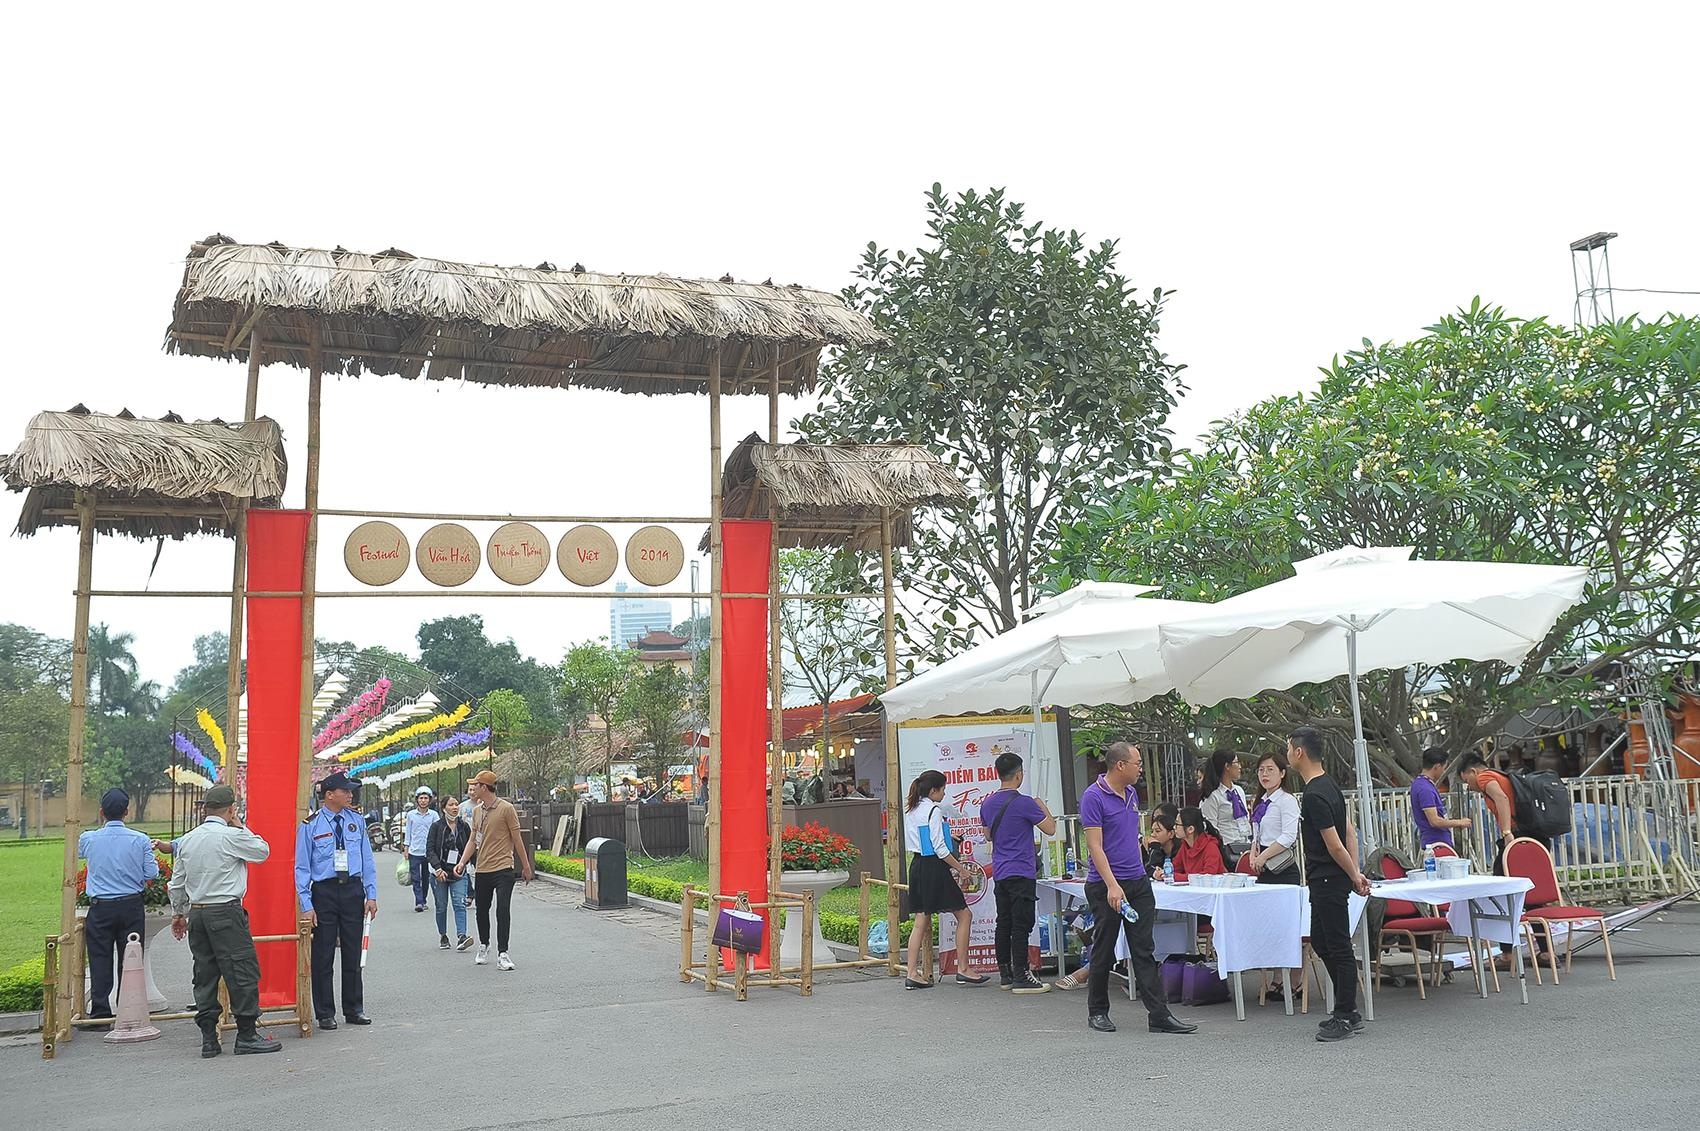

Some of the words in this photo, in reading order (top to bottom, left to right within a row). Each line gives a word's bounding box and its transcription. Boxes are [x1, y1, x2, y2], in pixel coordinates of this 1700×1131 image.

[359, 539, 401, 562] Festival
[428, 547, 448, 563] Văn
[577, 547, 600, 564] Việt
[640, 548, 669, 561] 2019
